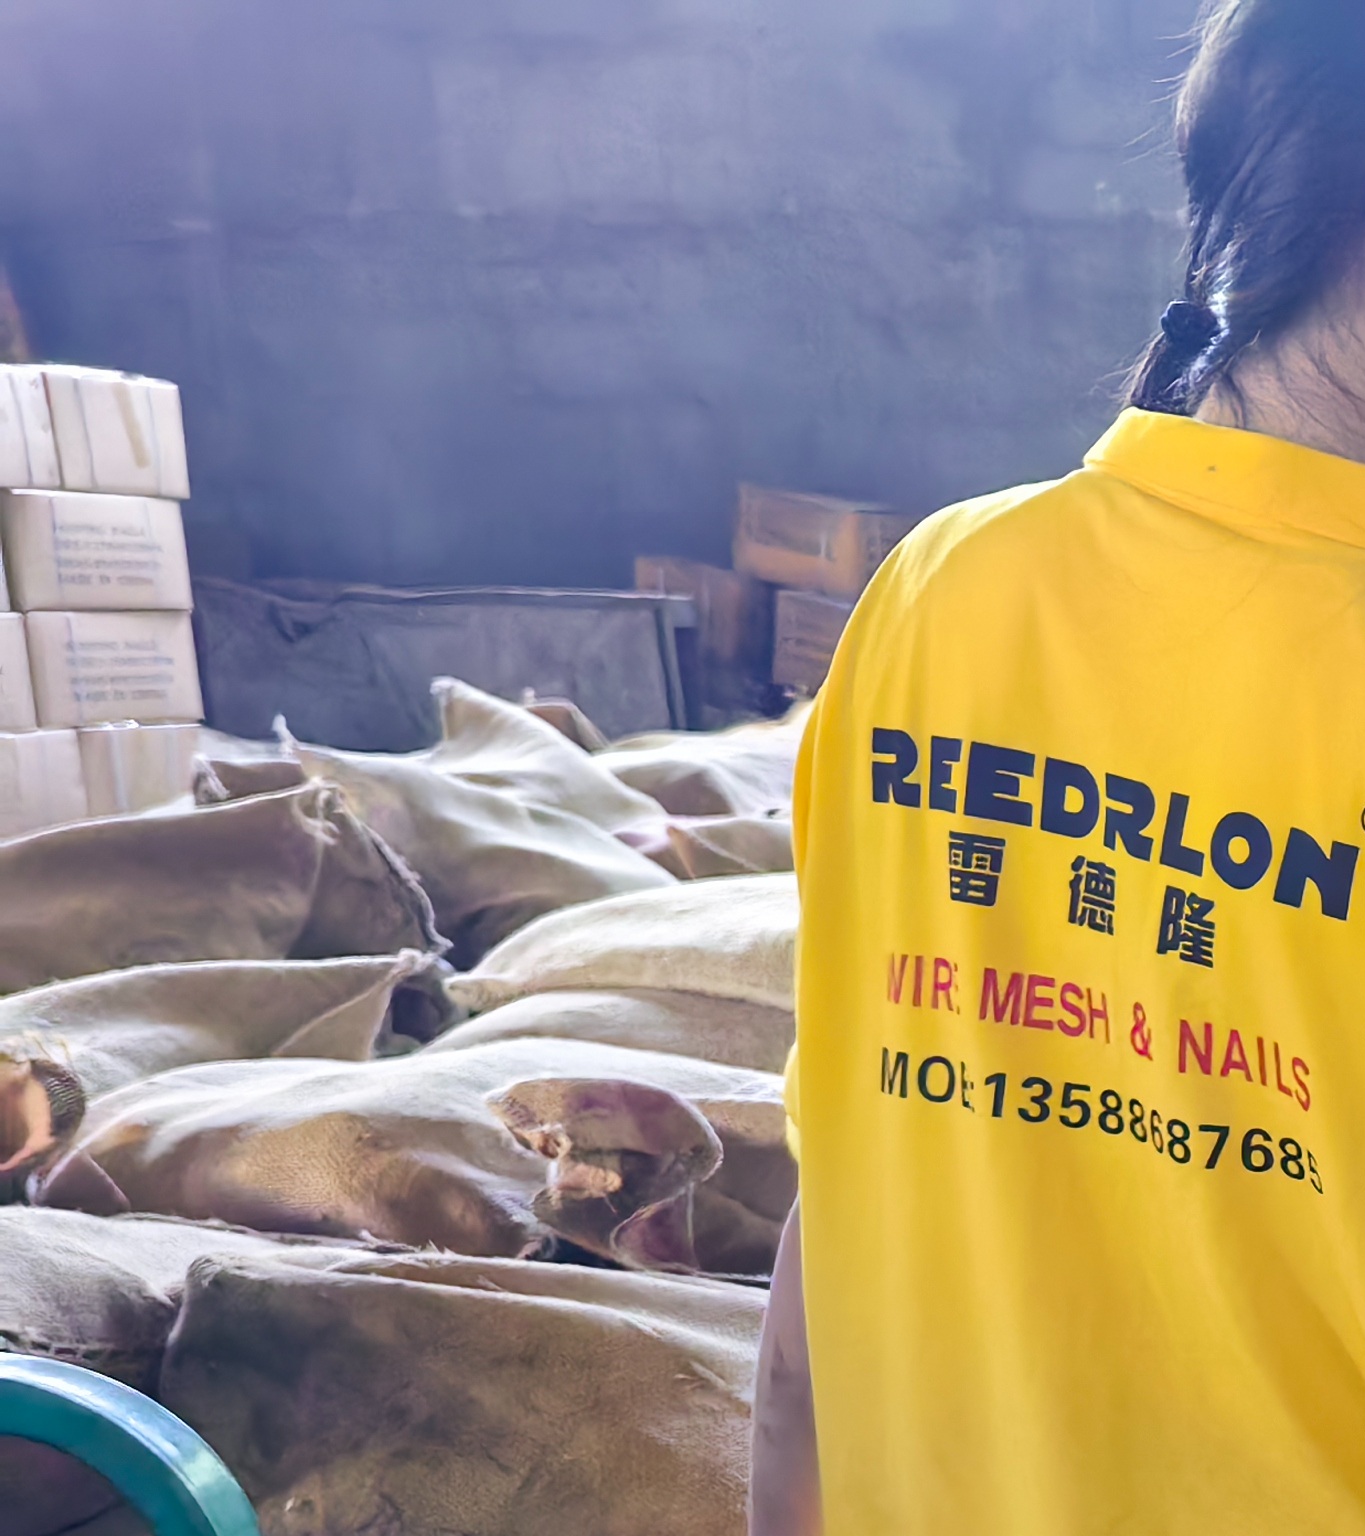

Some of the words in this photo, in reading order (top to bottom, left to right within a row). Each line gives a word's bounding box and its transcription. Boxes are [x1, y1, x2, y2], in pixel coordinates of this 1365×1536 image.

[979, 967, 1110, 1044] MESH
[1130, 1002, 1154, 1062] &
[1178, 1018, 1311, 1112] NAILS
